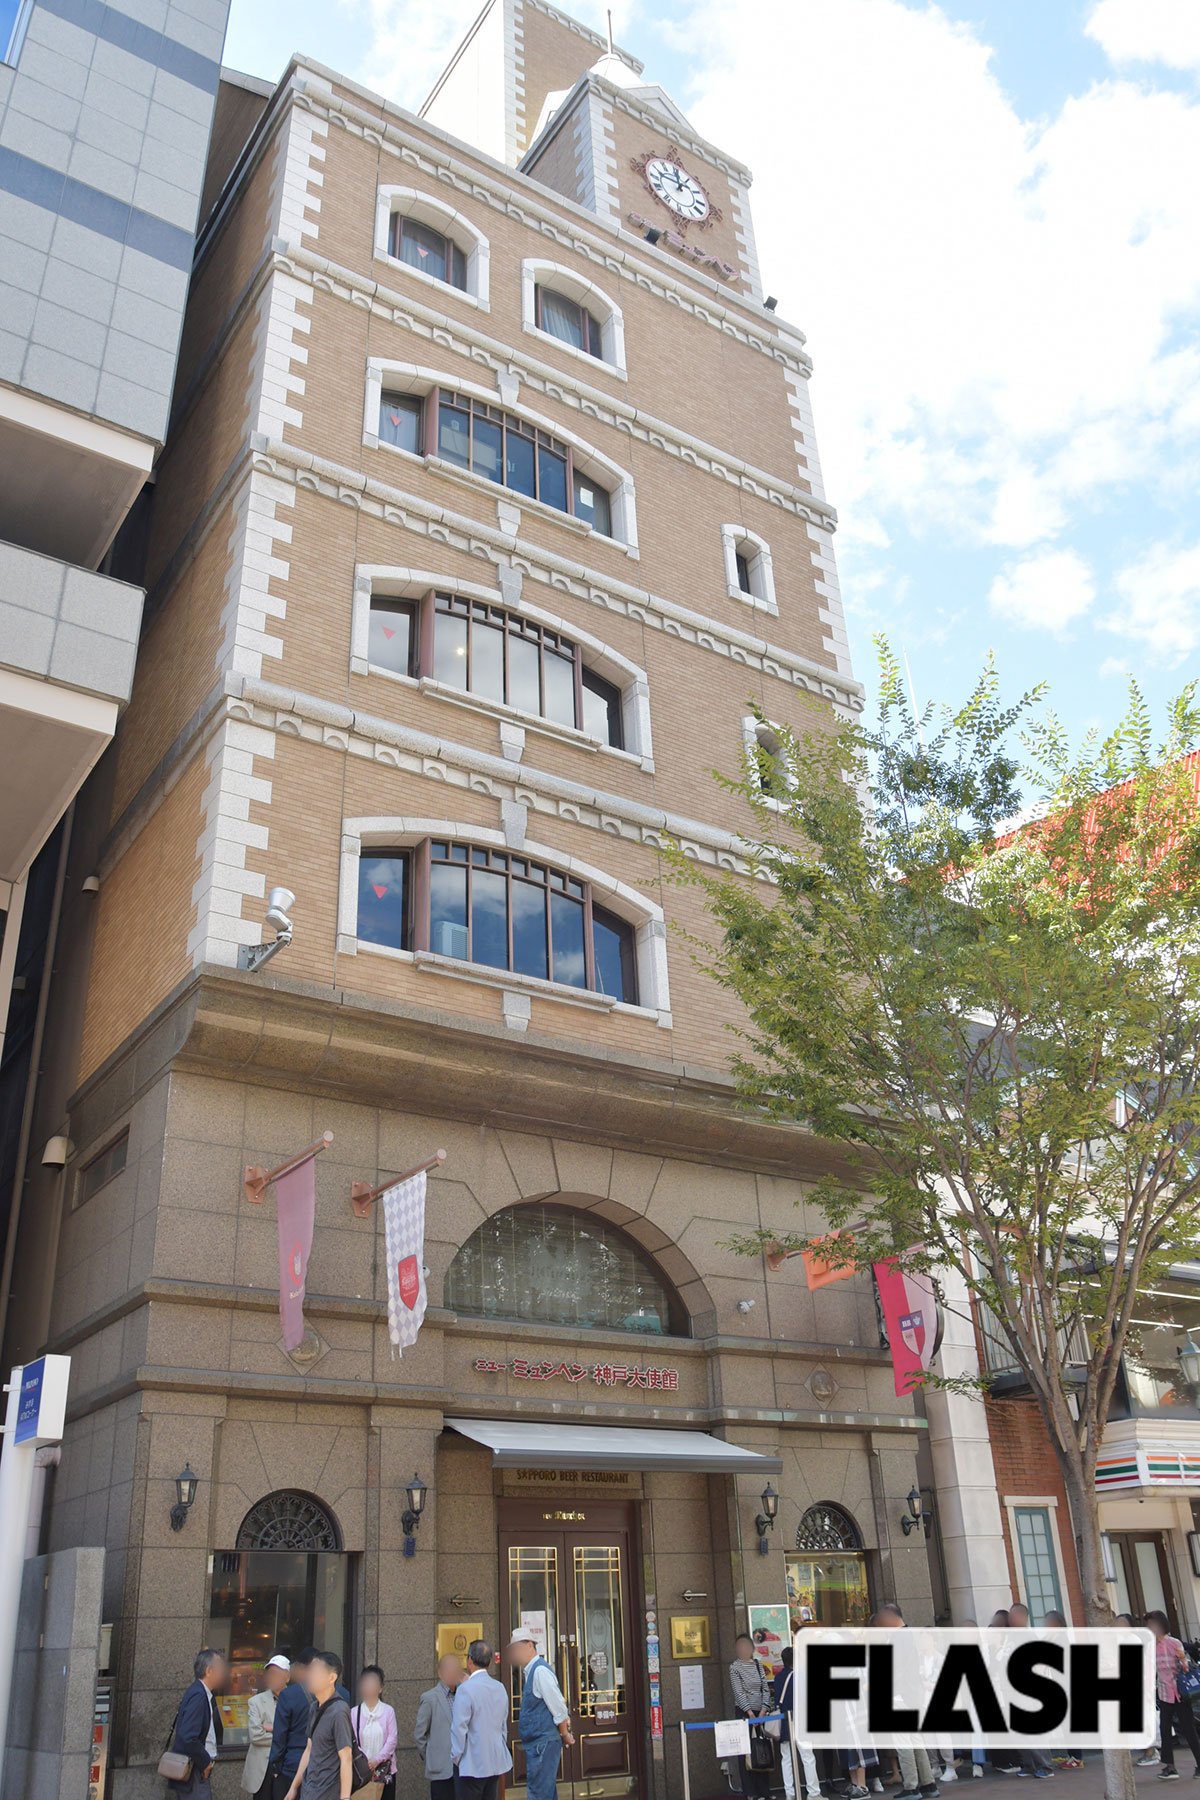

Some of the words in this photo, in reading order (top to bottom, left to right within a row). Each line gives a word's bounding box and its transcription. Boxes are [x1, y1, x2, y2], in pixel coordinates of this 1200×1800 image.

[475, 1358, 507, 1371] ニュー
[513, 1358, 588, 1382] ミュンヘン
[593, 1363, 680, 1391] 神戸大使館
[559, 1470, 579, 1482] BEER
[581, 1471, 630, 1484] RESTAURANT
